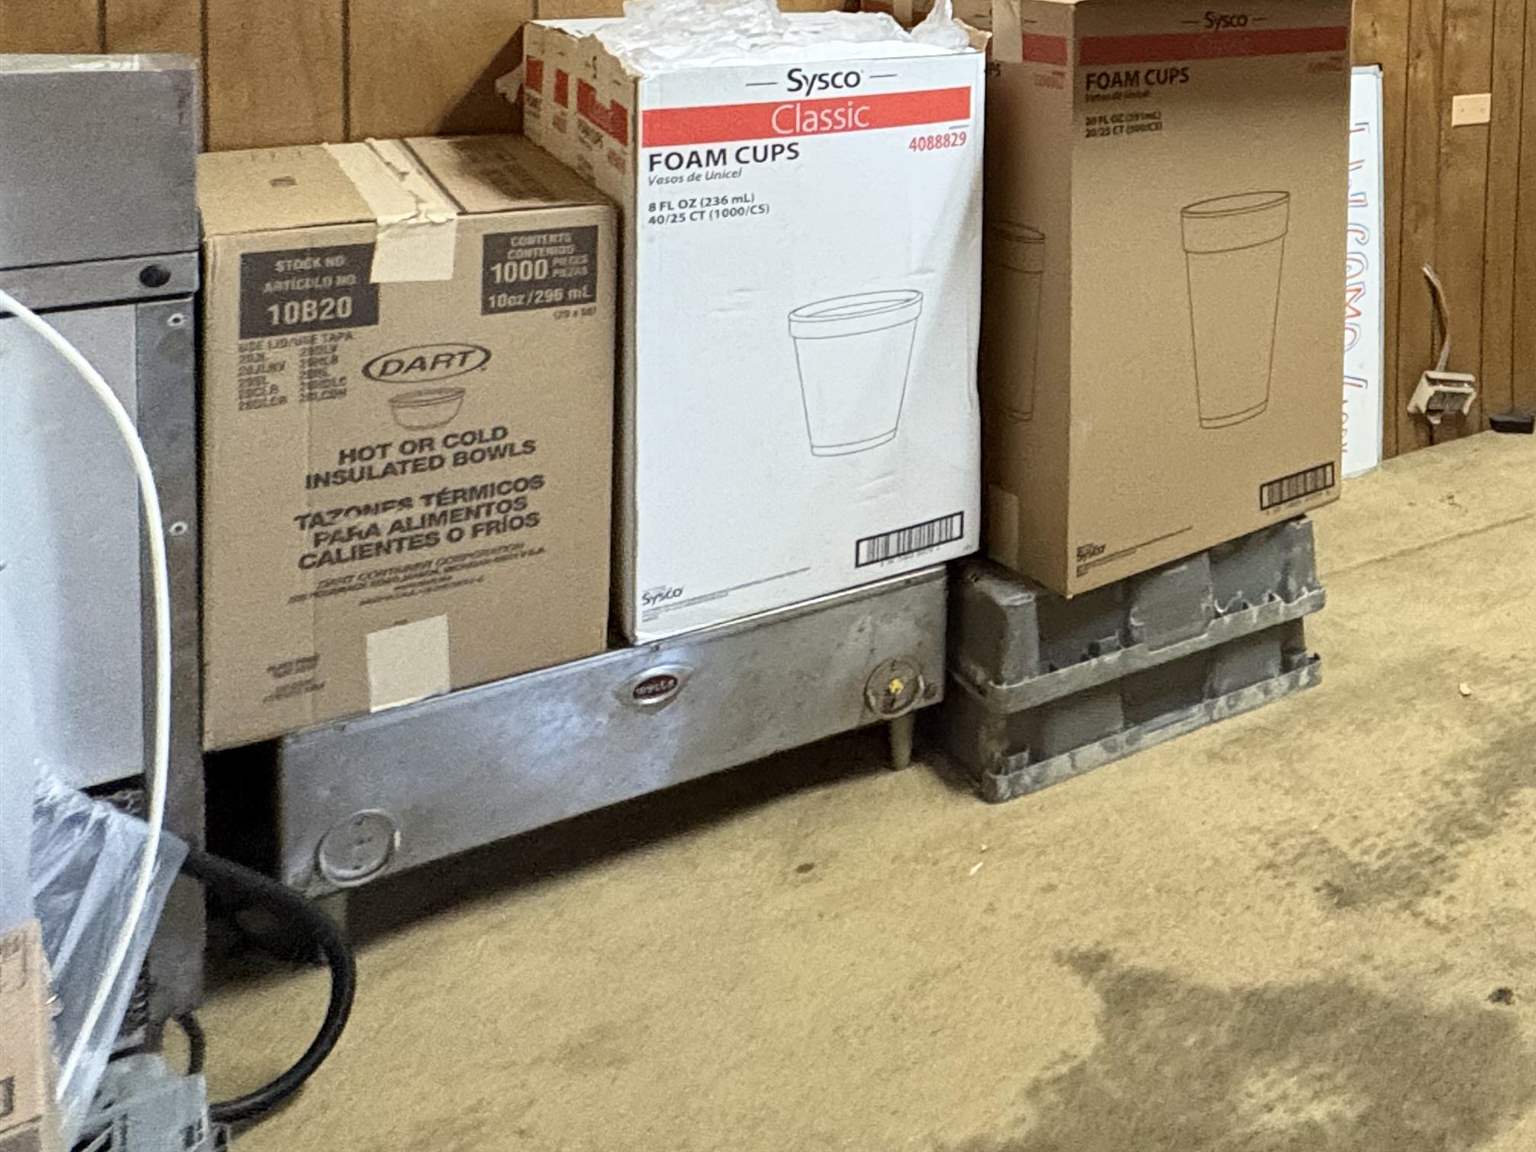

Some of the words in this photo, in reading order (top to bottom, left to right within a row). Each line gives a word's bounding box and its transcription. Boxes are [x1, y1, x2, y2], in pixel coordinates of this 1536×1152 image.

[1204, 11, 1248, 33] Sysco
[786, 68, 861, 96] Sysco
[1085, 70, 1140, 90] FOAM
[1144, 67, 1190, 86] CUPS
[771, 101, 870, 134] Classic
[908, 132, 967, 152] 4088829
[649, 148, 728, 172] FOAM
[734, 142, 800, 165] CUPS
[648, 174, 683, 186] Vasos
[687, 172, 702, 183] de
[705, 167, 742, 180] Unicel
[648, 202, 657, 212] 8
[659, 200, 674, 211] FL
[678, 198, 697, 209] OZ
[700, 195, 728, 208] (236
[732, 193, 756, 204] mL)
[648, 211, 686, 225] 40/25
[689, 210, 706, 221] CT
[709, 203, 770, 220] (1000/CS)
[275, 256, 321, 272] STOCK
[491, 259, 548, 284] 1000
[489, 288, 564, 308] 10oz/296
[568, 285, 592, 301] mL
[267, 296, 352, 325] 10B20
[379, 349, 476, 378] DART
[338, 442, 393, 465] HOT
[400, 437, 435, 456] OR
[442, 426, 509, 448] COLD
[305, 454, 445, 489] INSULATED
[452, 439, 537, 467] BOWLS
[293, 496, 414, 531] TAZONES
[419, 474, 545, 508] TÉRMICOS
[313, 523, 381, 548] PARA
[387, 496, 529, 536] ALIMENTOS
[298, 530, 441, 570] CALIENTES
[446, 527, 465, 543] O
[470, 512, 541, 538] FRÍOS
[642, 586, 684, 606] Sysco
